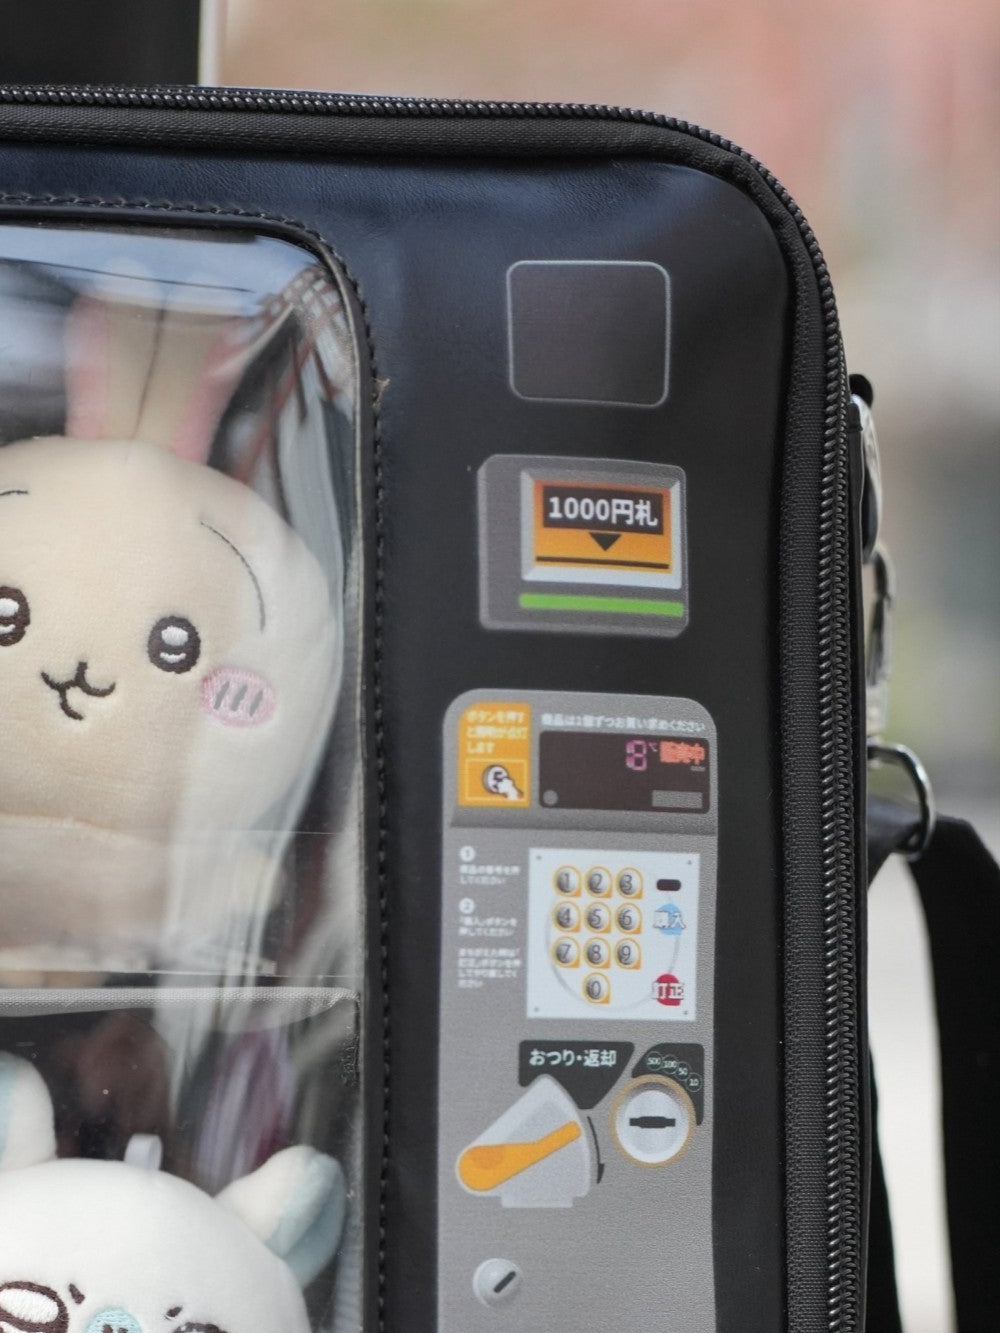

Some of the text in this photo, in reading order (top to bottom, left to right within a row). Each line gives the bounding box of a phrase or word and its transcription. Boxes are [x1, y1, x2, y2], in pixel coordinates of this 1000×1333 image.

[548, 495, 659, 527] 1000円札
[529, 1049, 617, 1068] おつり・返却
[689, 1078, 700, 1087] 10
